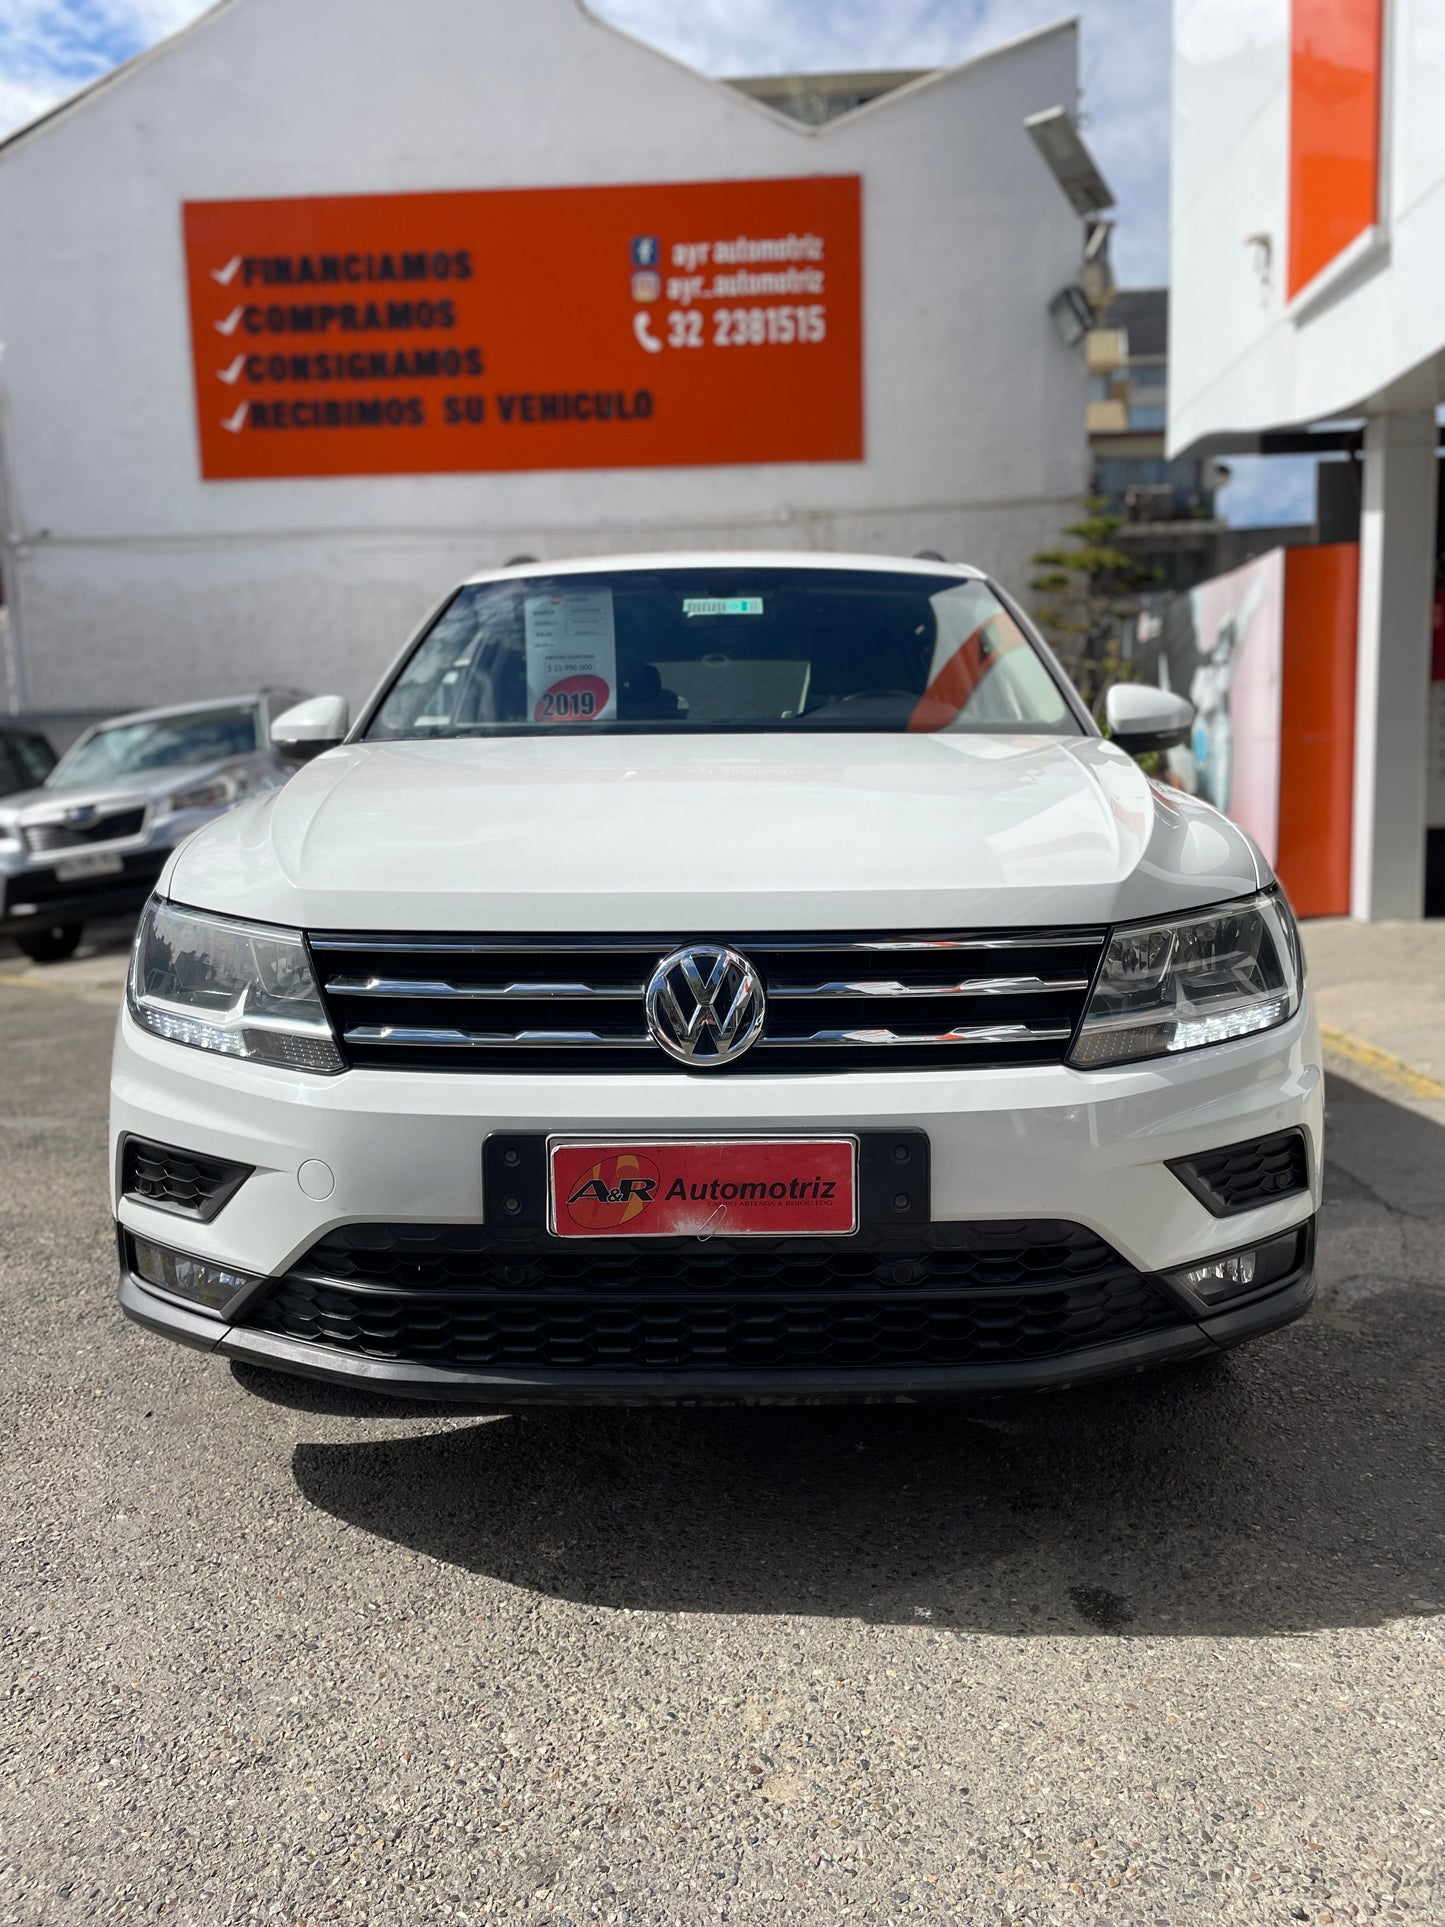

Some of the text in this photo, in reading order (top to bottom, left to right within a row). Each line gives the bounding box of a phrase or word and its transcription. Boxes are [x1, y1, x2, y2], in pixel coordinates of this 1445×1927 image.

[243, 251, 473, 286] FINANCIAMOS
[672, 233, 824, 271] ayr automotriz
[244, 299, 456, 335] COMPRAMOS
[667, 305, 826, 348] 32 2381515
[246, 348, 484, 383] CONSIGNAMOS
[251, 391, 653, 430] RECIBIMOS SU VEHICULO
[541, 692, 594, 717] 2019
[646, 945, 765, 1066] VW
[565, 1176, 837, 1204] A&R Automotriz
